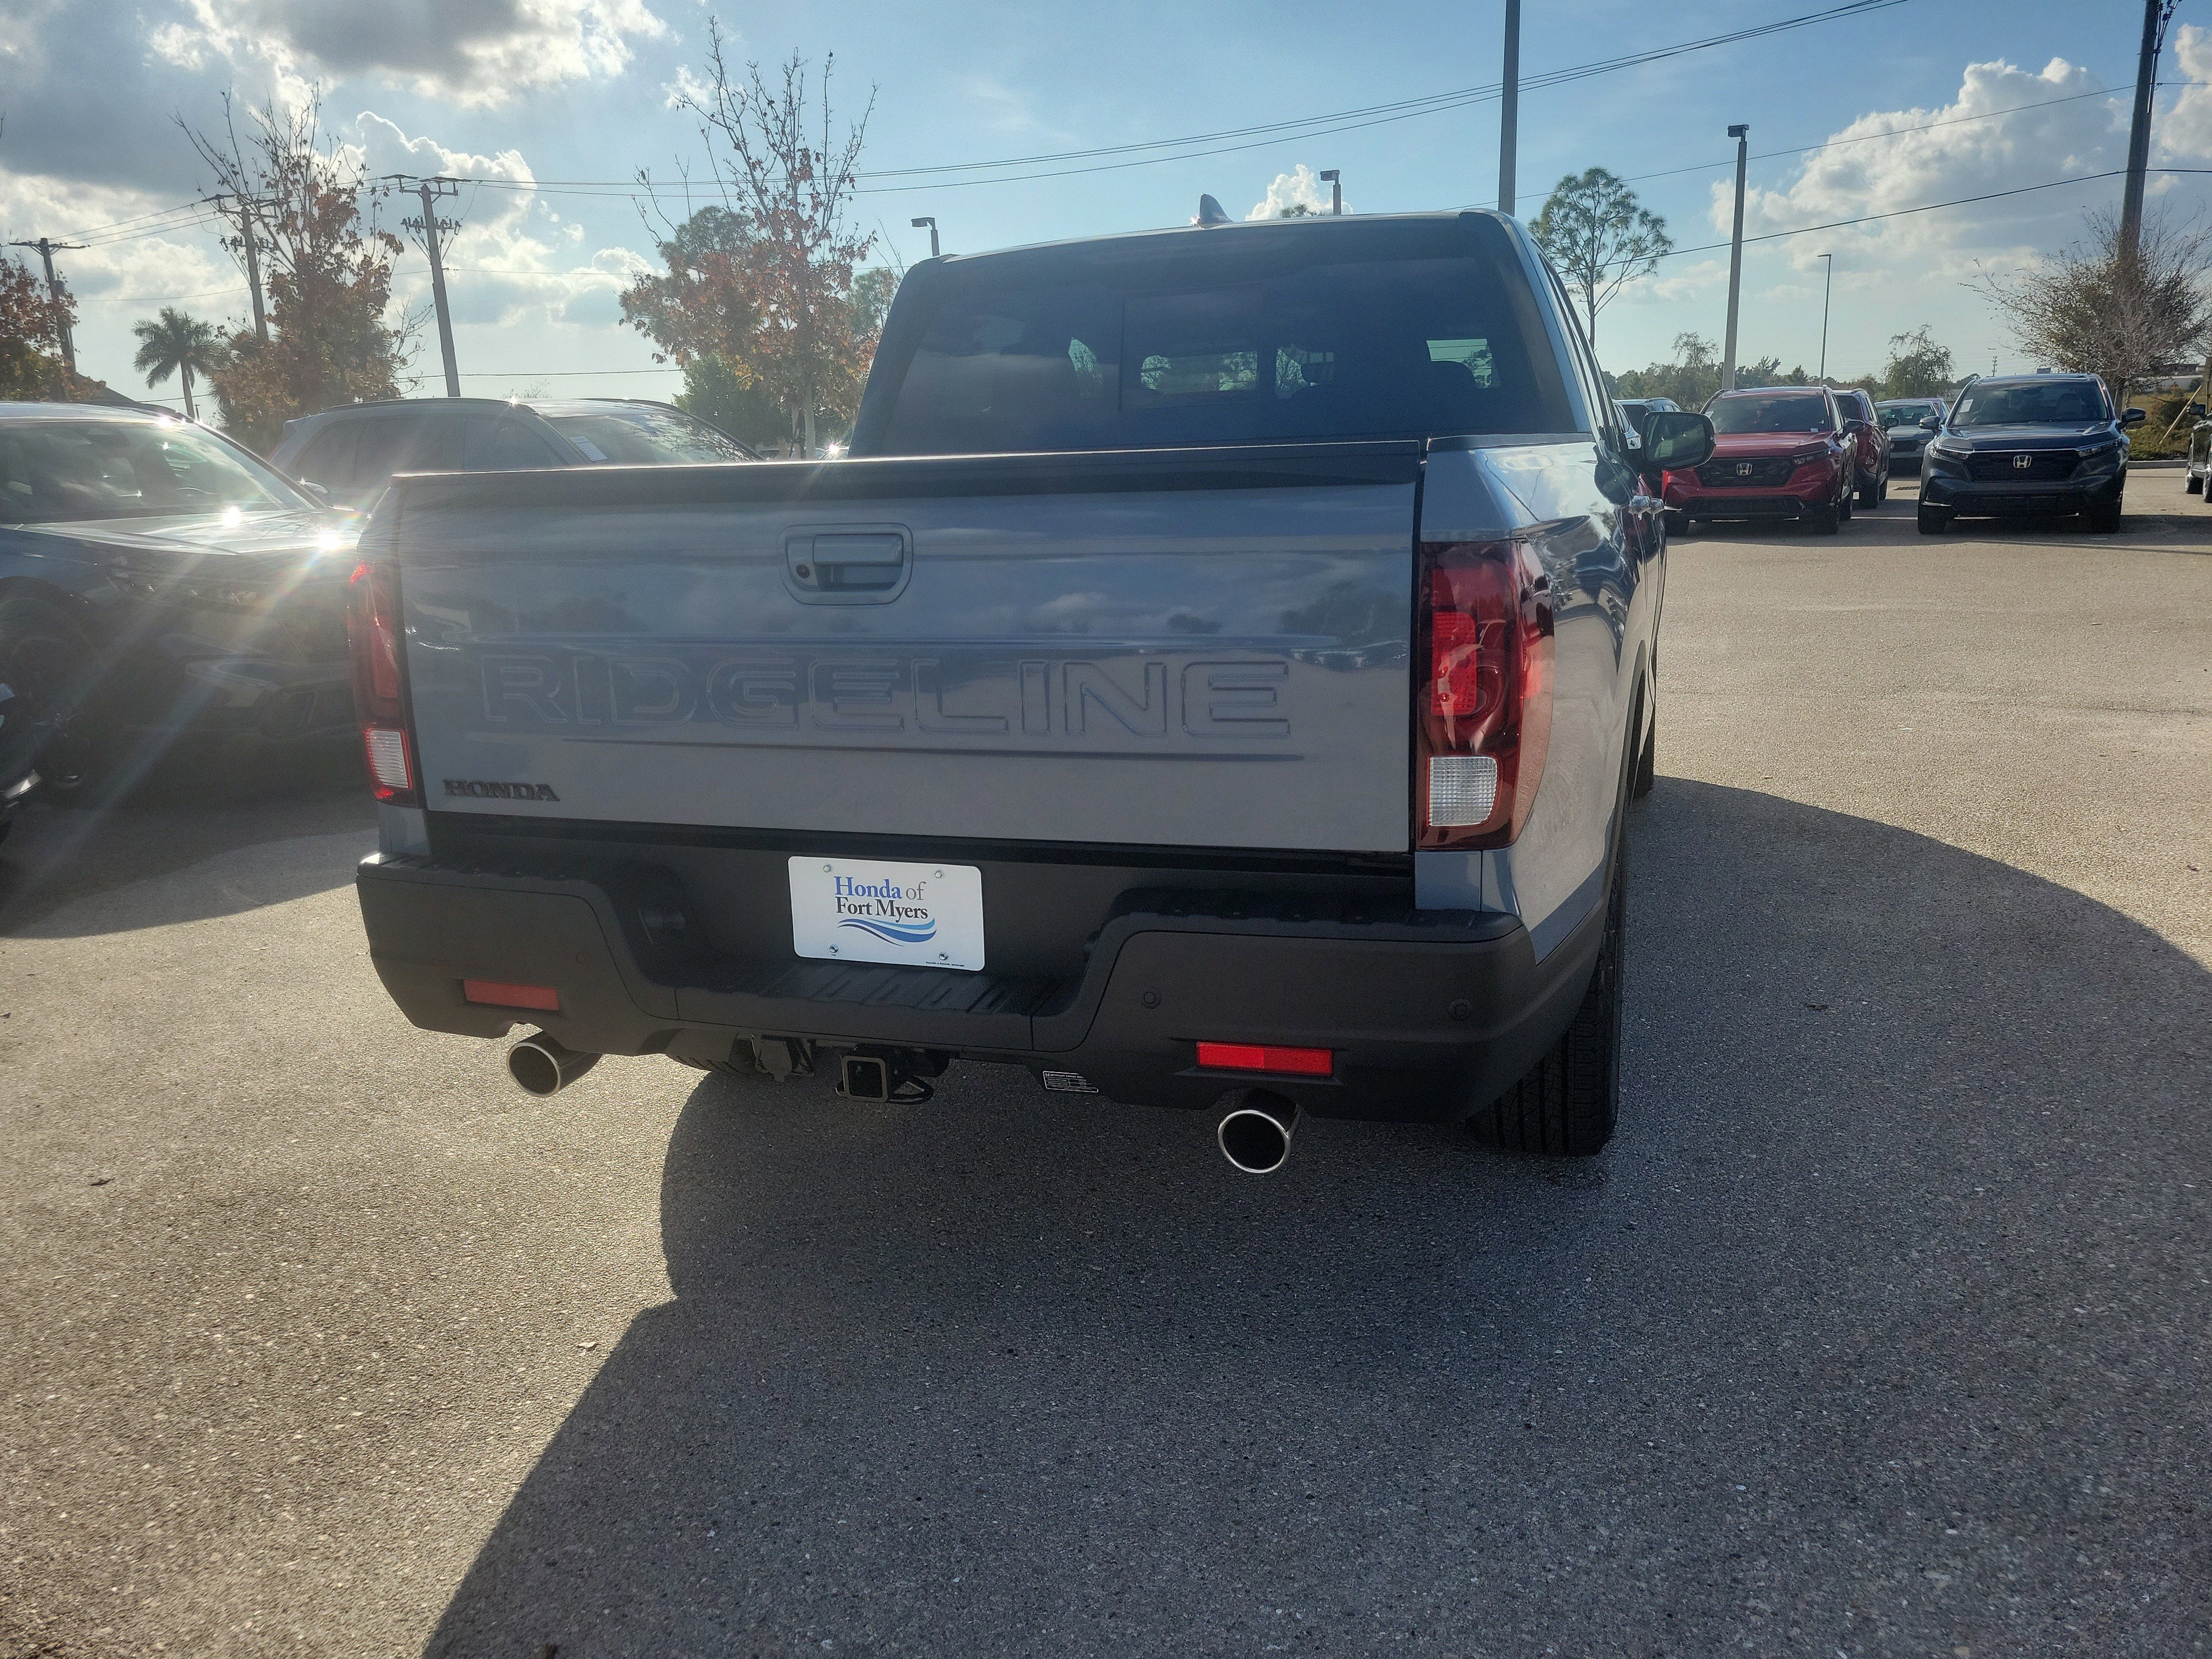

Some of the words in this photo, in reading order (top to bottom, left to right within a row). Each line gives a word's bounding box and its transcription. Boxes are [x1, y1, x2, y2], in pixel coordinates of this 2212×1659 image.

[480, 653, 1291, 738] RIDGELINE
[442, 779, 561, 802] HONDA
[834, 876, 902, 899] Honda
[906, 881, 927, 900] of
[836, 897, 872, 916] Fort
[874, 899, 928, 923] Myers
